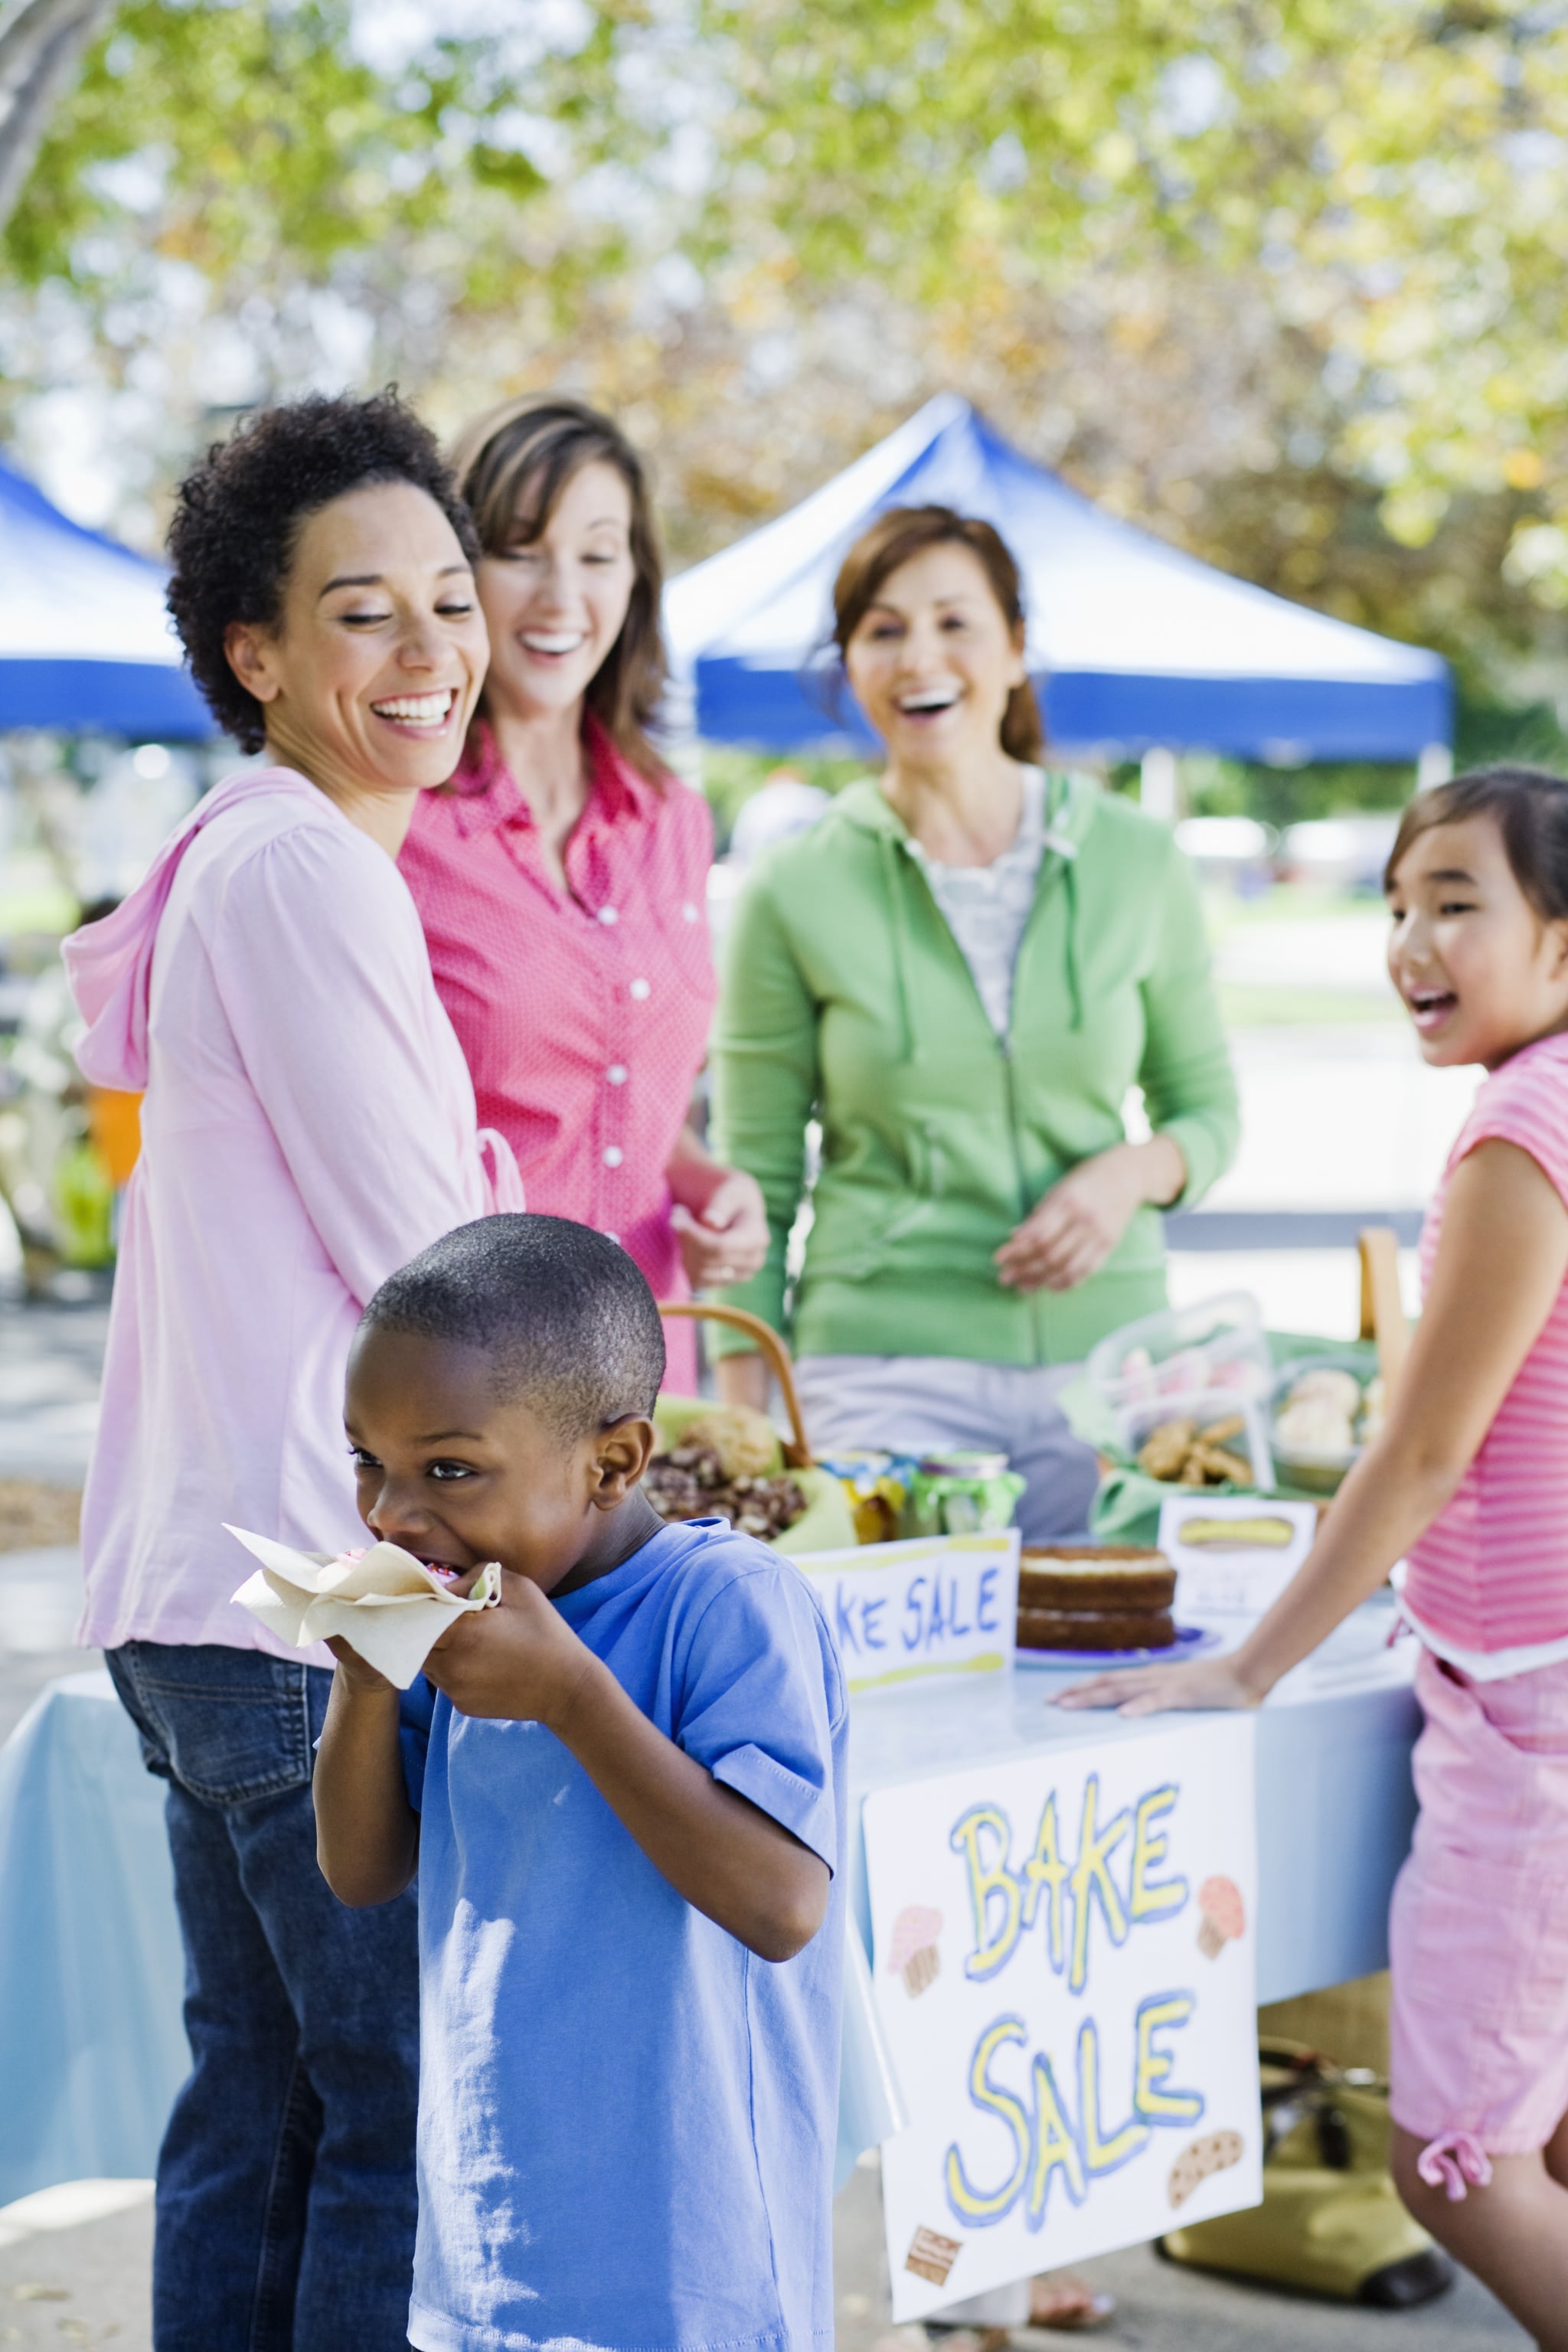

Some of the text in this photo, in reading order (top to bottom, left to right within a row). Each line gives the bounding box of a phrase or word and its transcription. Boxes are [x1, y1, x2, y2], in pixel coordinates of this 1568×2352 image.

[818, 1566, 999, 1657] KE SALE
[950, 1772, 1189, 1996] BAKE
[944, 1989, 1205, 2233] SALE
